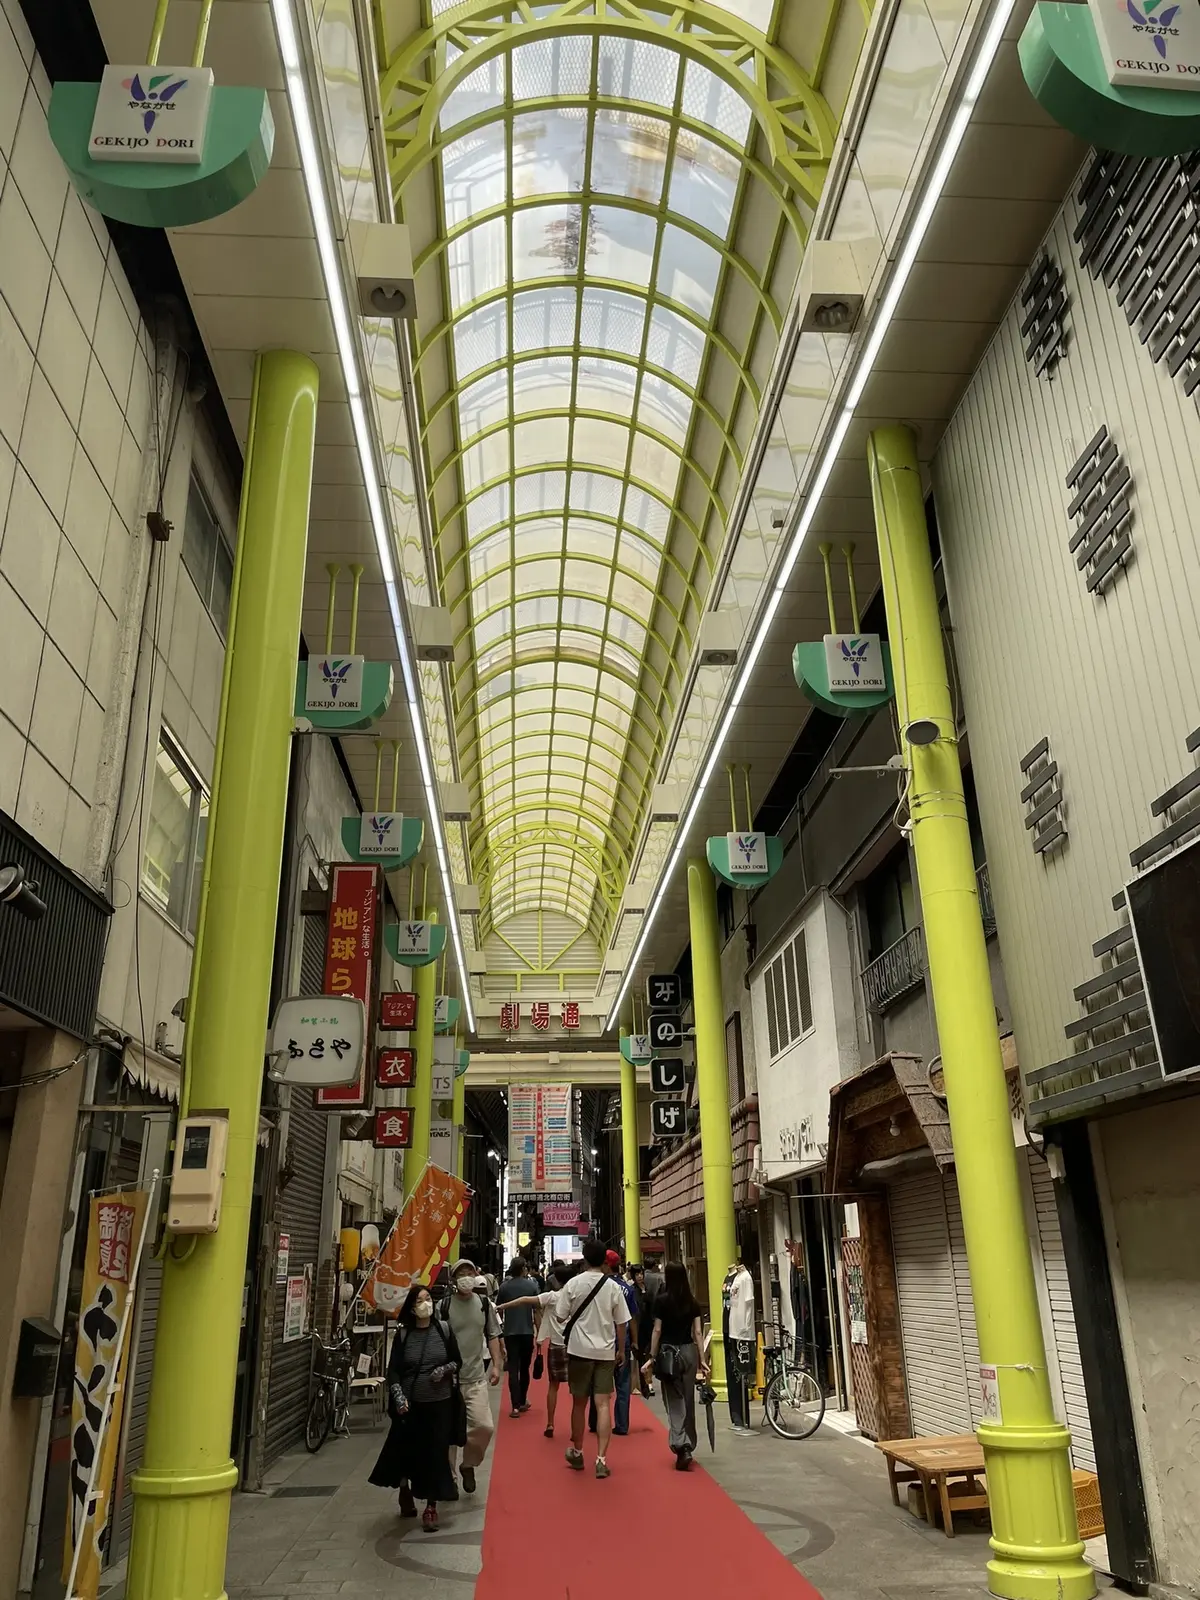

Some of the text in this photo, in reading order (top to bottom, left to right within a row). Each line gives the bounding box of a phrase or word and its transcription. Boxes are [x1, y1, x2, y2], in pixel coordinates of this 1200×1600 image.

[1132, 24, 1180, 36] やながせ
[1116, 58, 1170, 74] GEKIJO
[127, 100, 176, 110] やながせ
[94, 135, 195, 149] GEKIJO DORI
[831, 679, 860, 687] GEKIJO
[500, 1001, 580, 1031] 劇場通
[385, 1056, 406, 1078] 衣
[383, 1115, 404, 1137] 食
